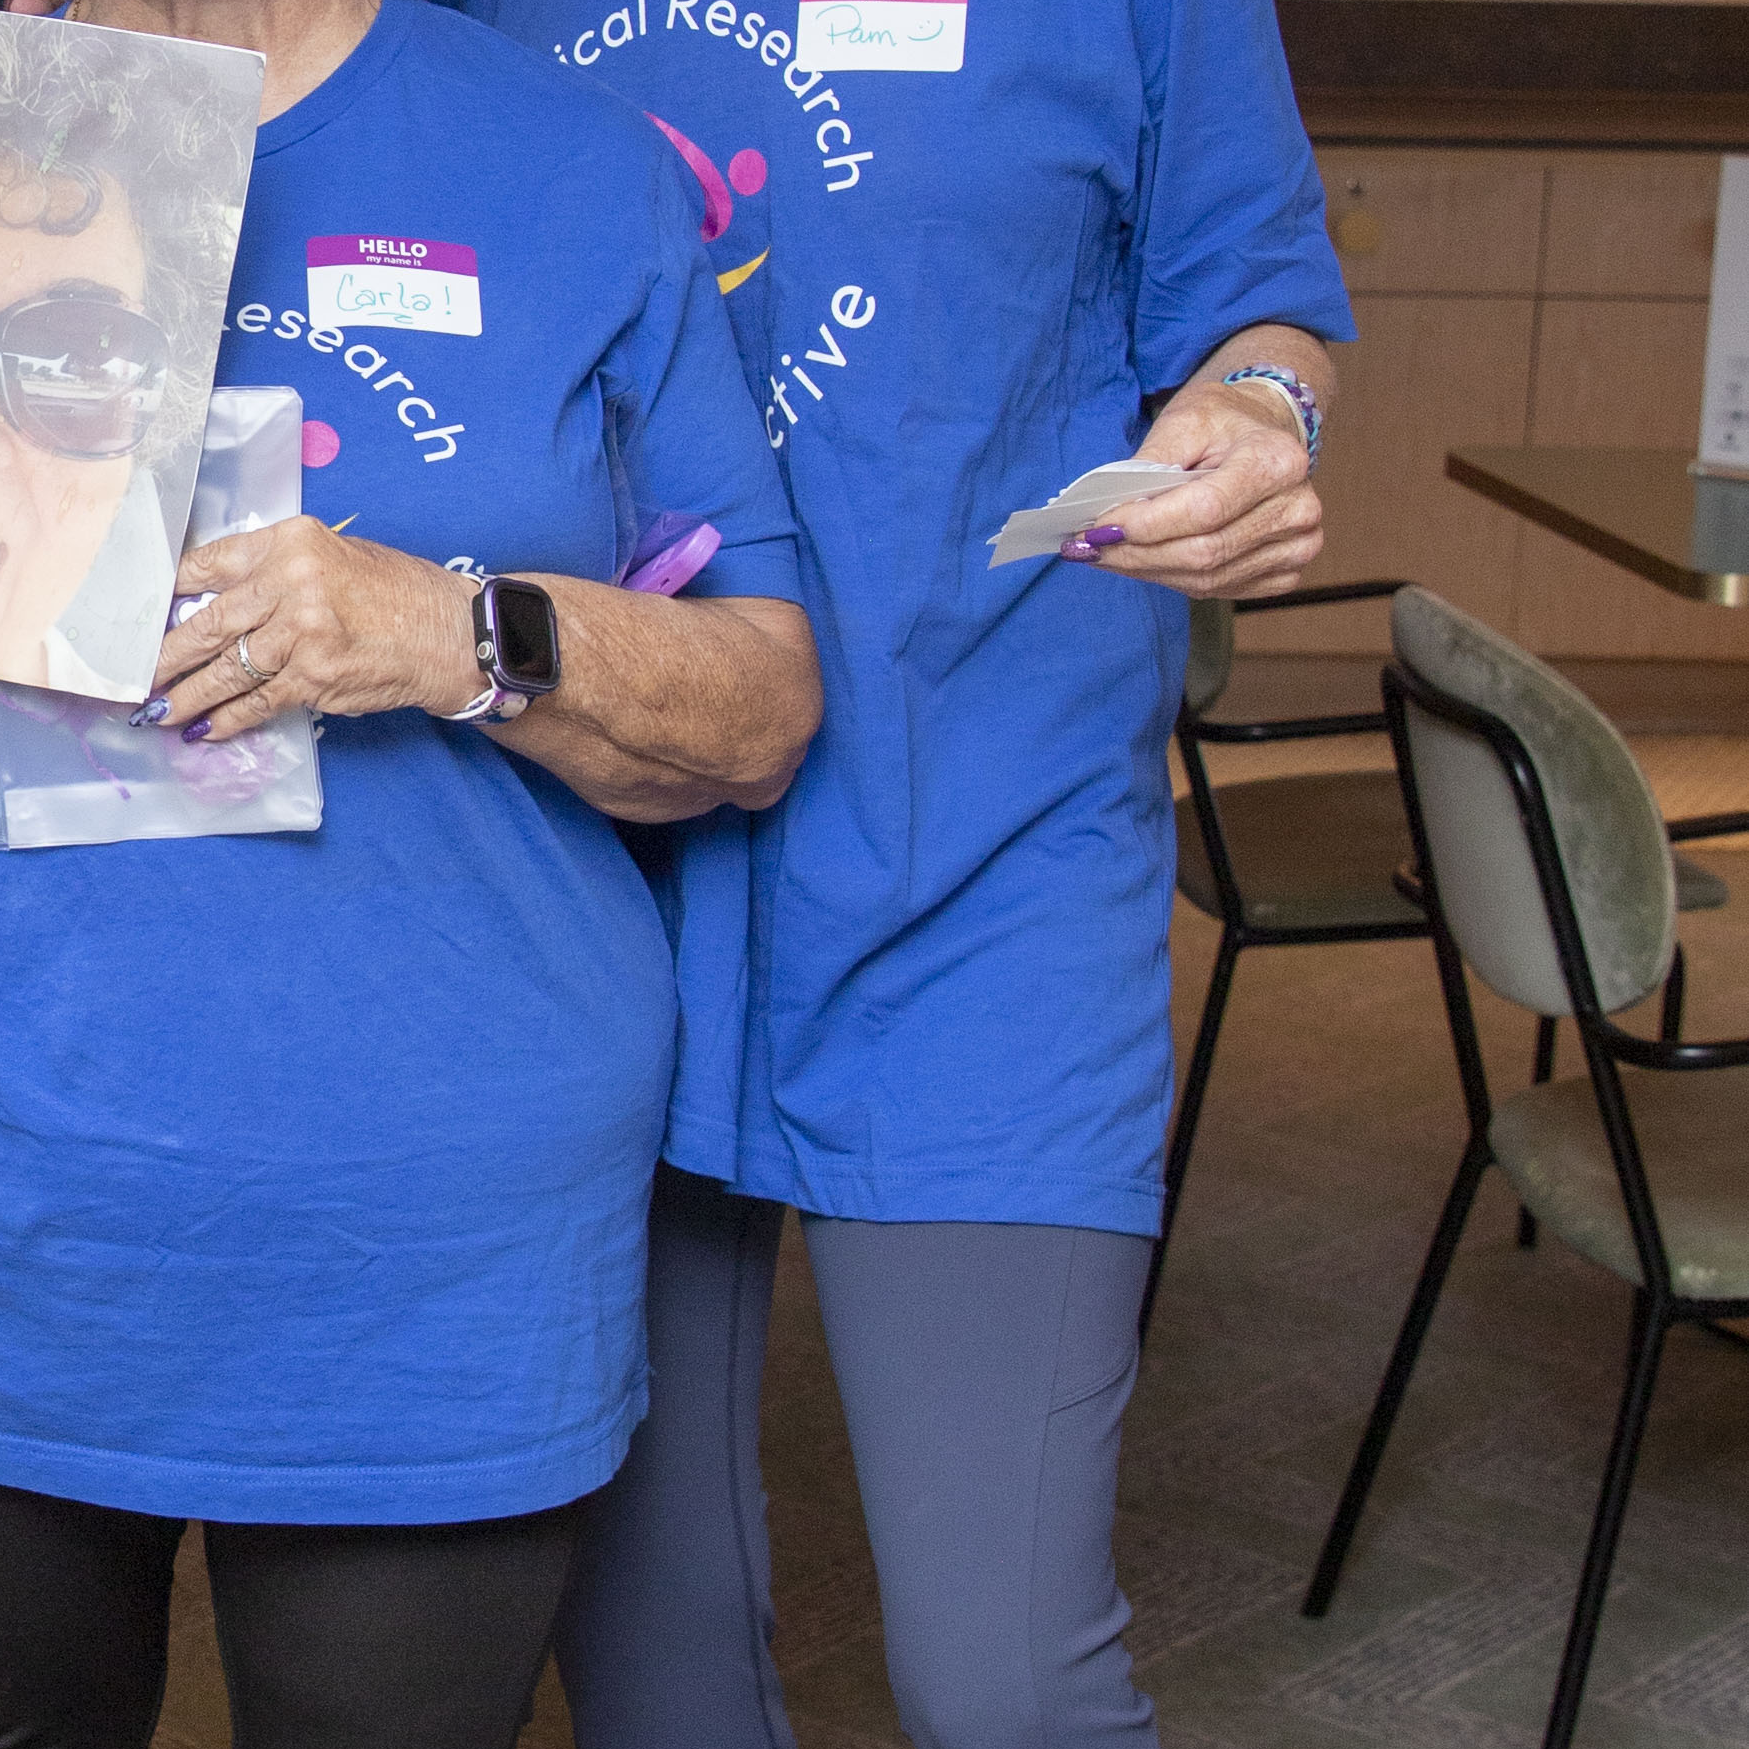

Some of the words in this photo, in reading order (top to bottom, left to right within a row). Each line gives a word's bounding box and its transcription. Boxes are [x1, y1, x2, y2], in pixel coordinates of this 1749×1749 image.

[816, 4, 898, 47] Pam
[358, 239, 428, 258] HELLO
[366, 255, 382, 264] my
[383, 257, 412, 266] name
[413, 258, 422, 267] is
[222, 303, 465, 463] esearch
